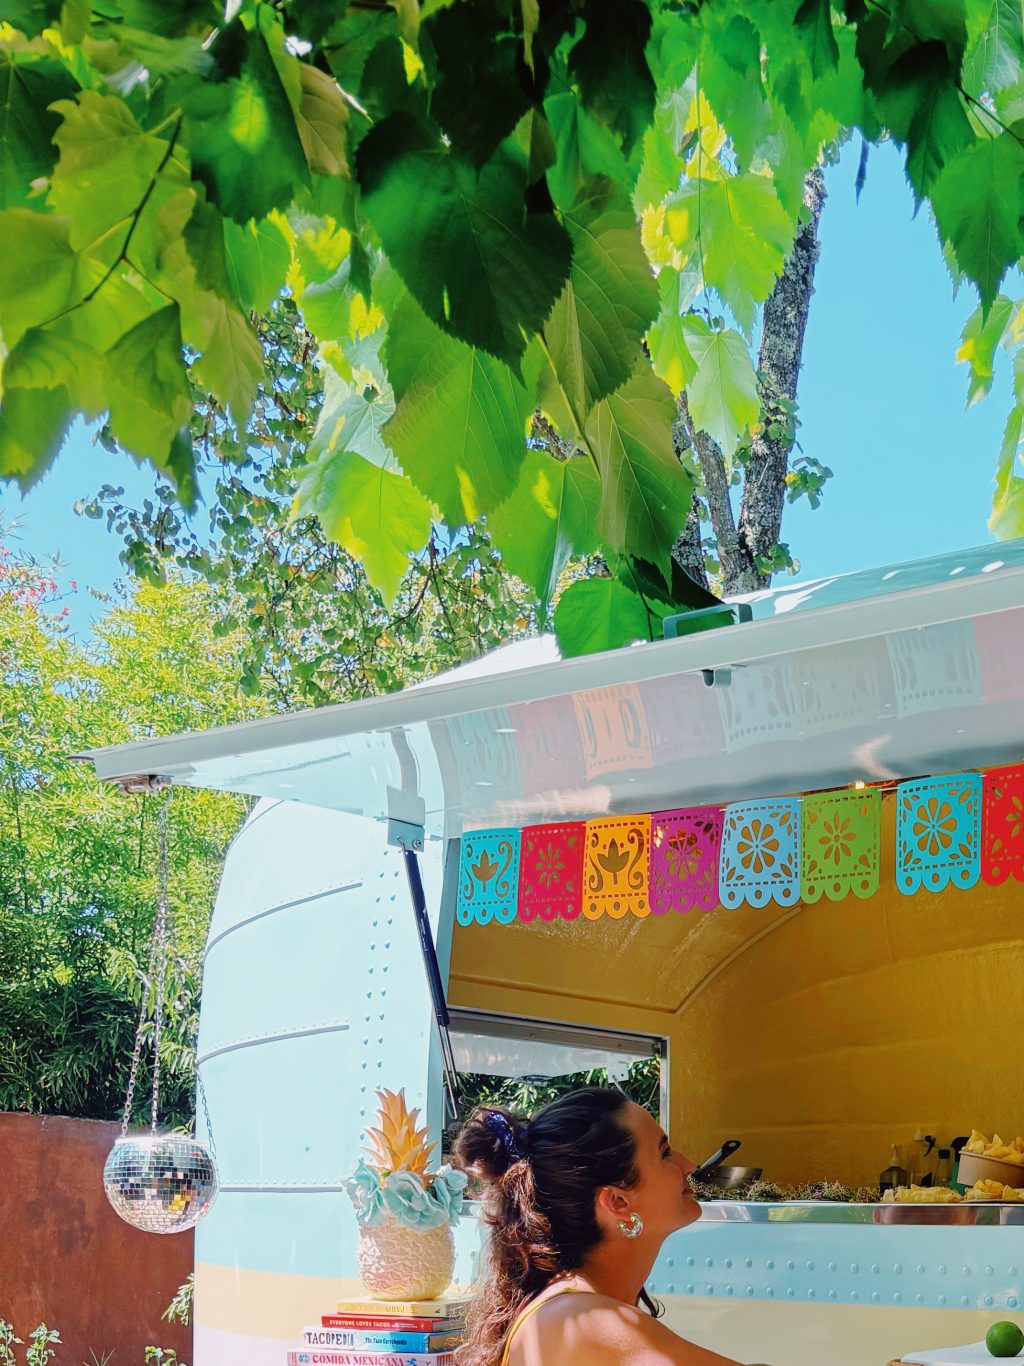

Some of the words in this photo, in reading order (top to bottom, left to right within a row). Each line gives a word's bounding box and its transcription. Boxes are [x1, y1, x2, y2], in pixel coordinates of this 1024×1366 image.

[306, 1332, 354, 1346] TACOPEDIA
[312, 1354, 351, 1365] COMIDA
[353, 1354, 404, 1366] MEXICANA
